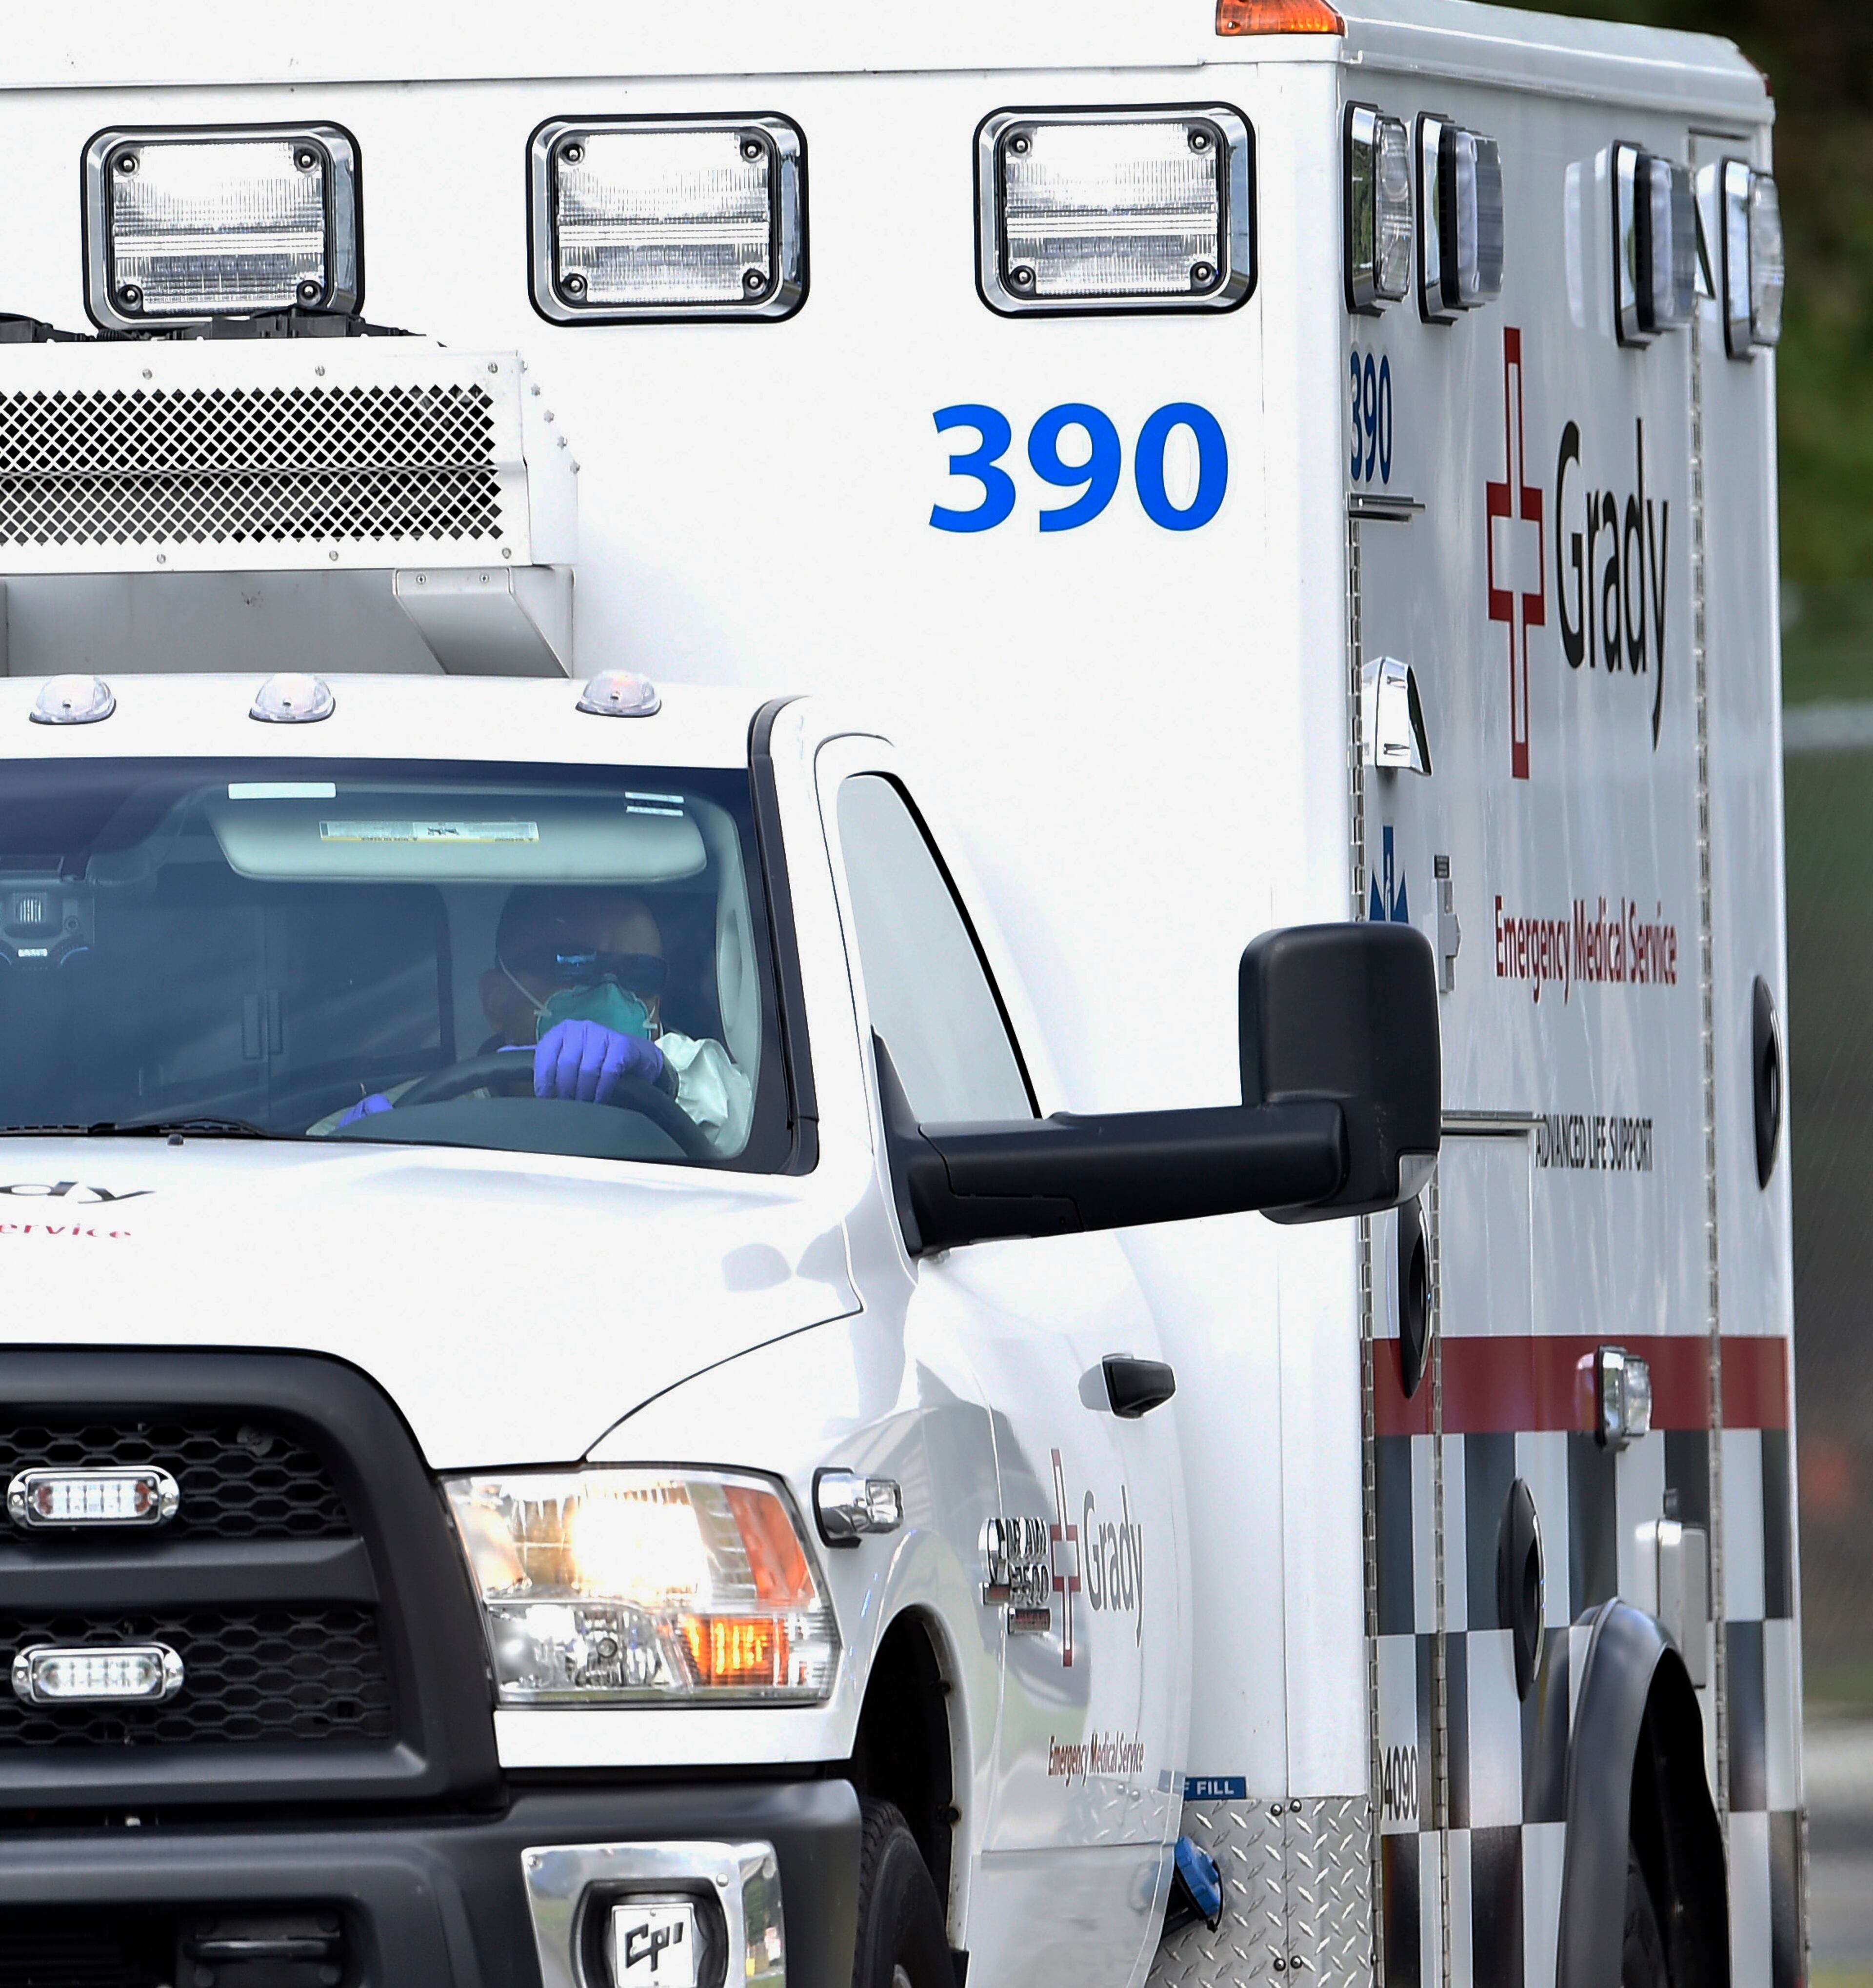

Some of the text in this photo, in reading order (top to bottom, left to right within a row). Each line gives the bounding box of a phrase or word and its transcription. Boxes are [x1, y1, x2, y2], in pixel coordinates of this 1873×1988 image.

[929, 402, 1228, 533] 390
[1350, 350, 1392, 484] 390
[1555, 417, 1669, 753] Grady
[1495, 895, 1677, 1005] Emergency Medical Service
[1535, 1114, 1653, 1171] ADVANCED LIFE SUPPORT
[1083, 1485, 1142, 1648] Grady
[1048, 1730, 1144, 1787] Emergency Medical Service
[1196, 1781, 1235, 1795] FILL
